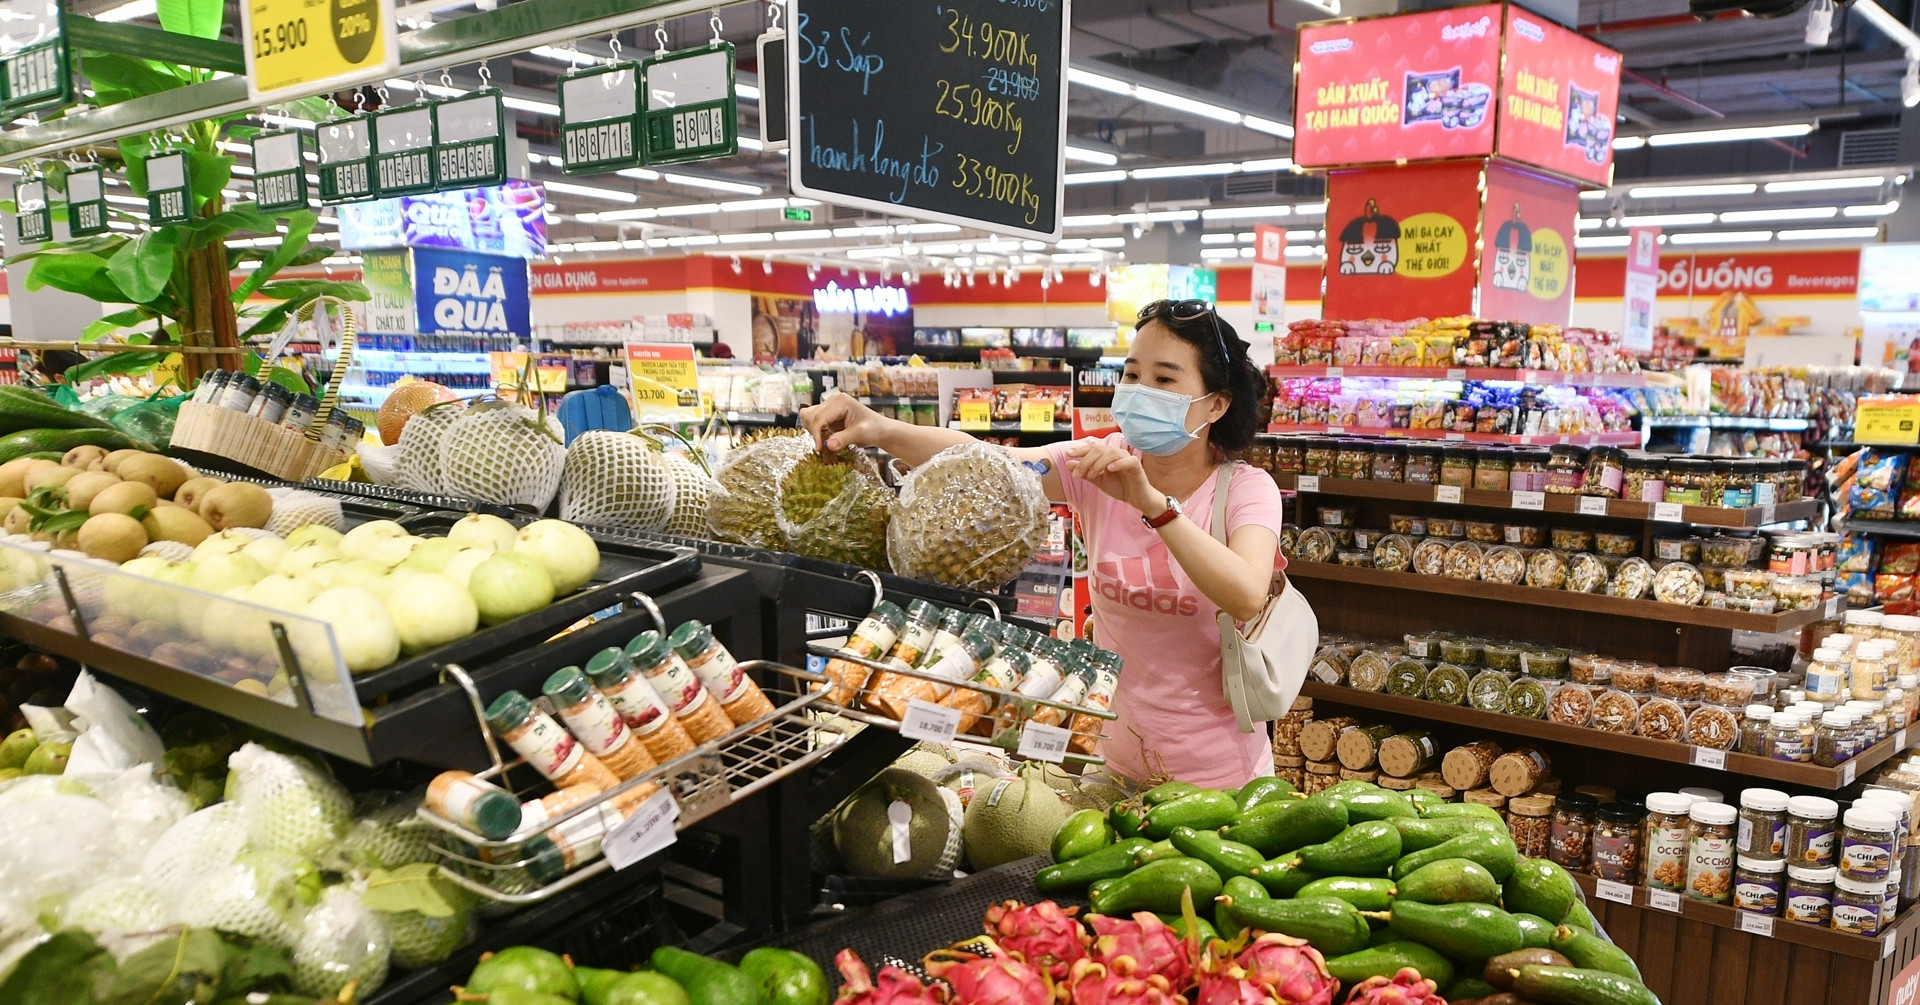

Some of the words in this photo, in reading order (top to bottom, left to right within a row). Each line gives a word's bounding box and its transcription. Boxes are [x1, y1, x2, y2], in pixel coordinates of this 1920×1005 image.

[339, 13, 371, 38] 20%
[255, 17, 307, 58] 15.900
[1434, 226, 1455, 238] CAY
[1415, 239, 1441, 254] NHẤT
[1406, 256, 1423, 271] THẾ
[1695, 258, 1773, 288] UỐNG
[1788, 273, 1856, 288] Beverages
[543, 272, 562, 288] GIA
[565, 271, 597, 291] DỤNG
[602, 278, 617, 286] Home
[619, 277, 648, 287] Appliances
[638, 389, 665, 400] 33.700
[1090, 567, 1199, 617] adidas
[1857, 853, 1878, 862] CHIA
[1745, 891, 1764, 899] CHIA
[1801, 904, 1821, 912] CHIA
[1842, 913, 1863, 923] CHIA
